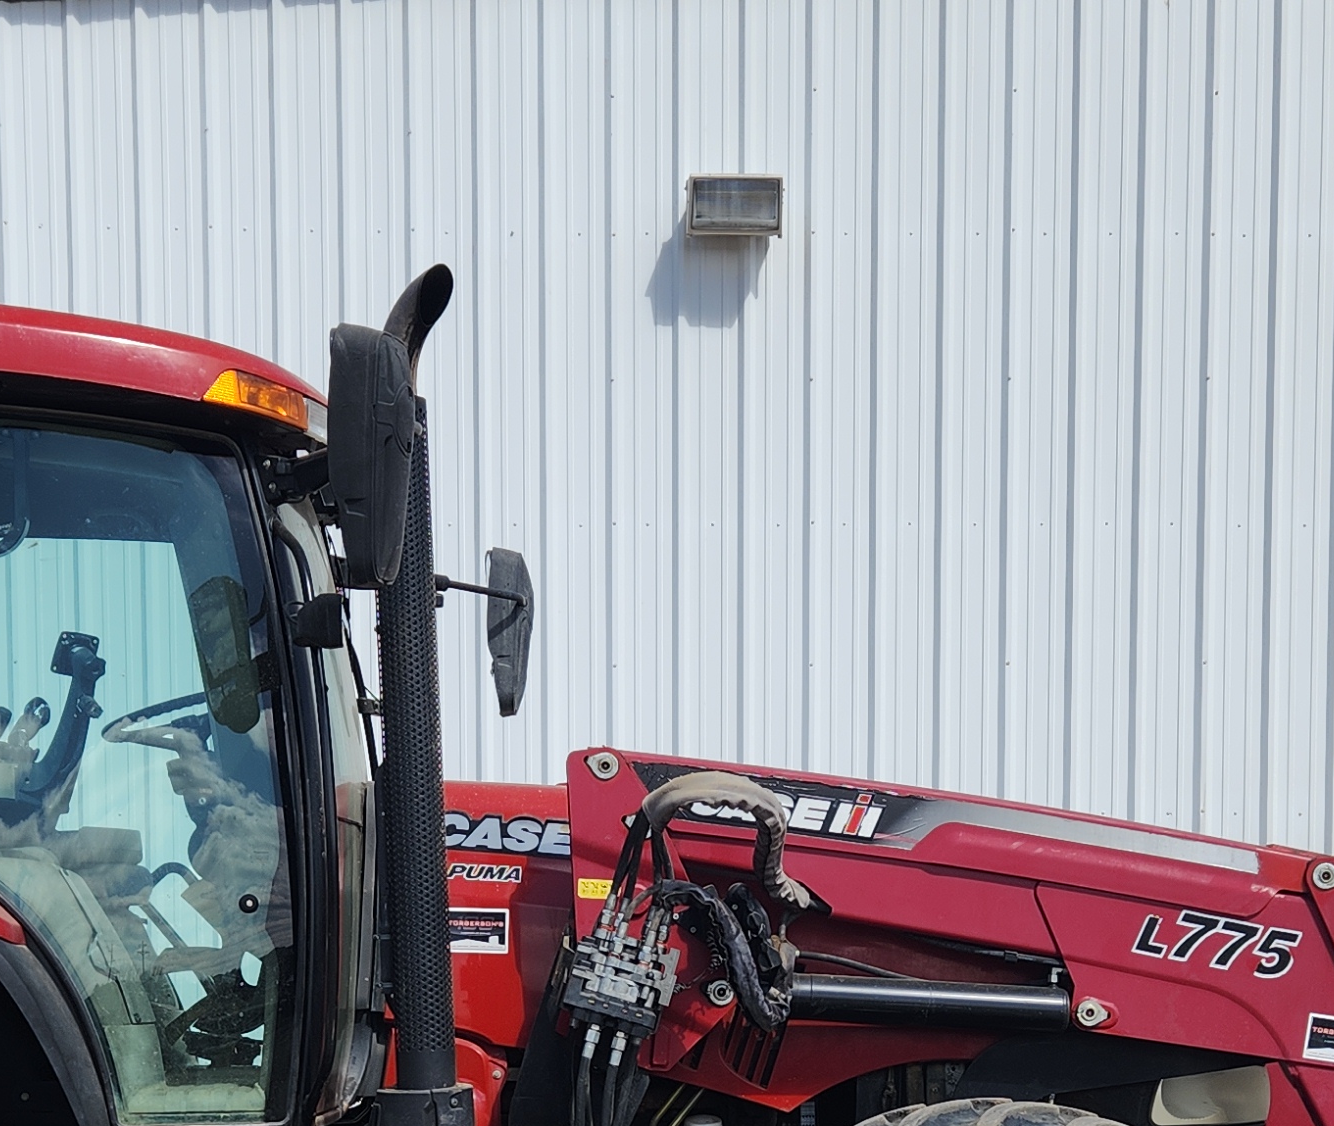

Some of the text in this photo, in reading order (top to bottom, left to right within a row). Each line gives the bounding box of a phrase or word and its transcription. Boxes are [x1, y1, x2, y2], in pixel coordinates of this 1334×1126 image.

[445, 812, 571, 855] CASE
[447, 863, 523, 883] PUMA
[1131, 909, 1303, 979] L775
